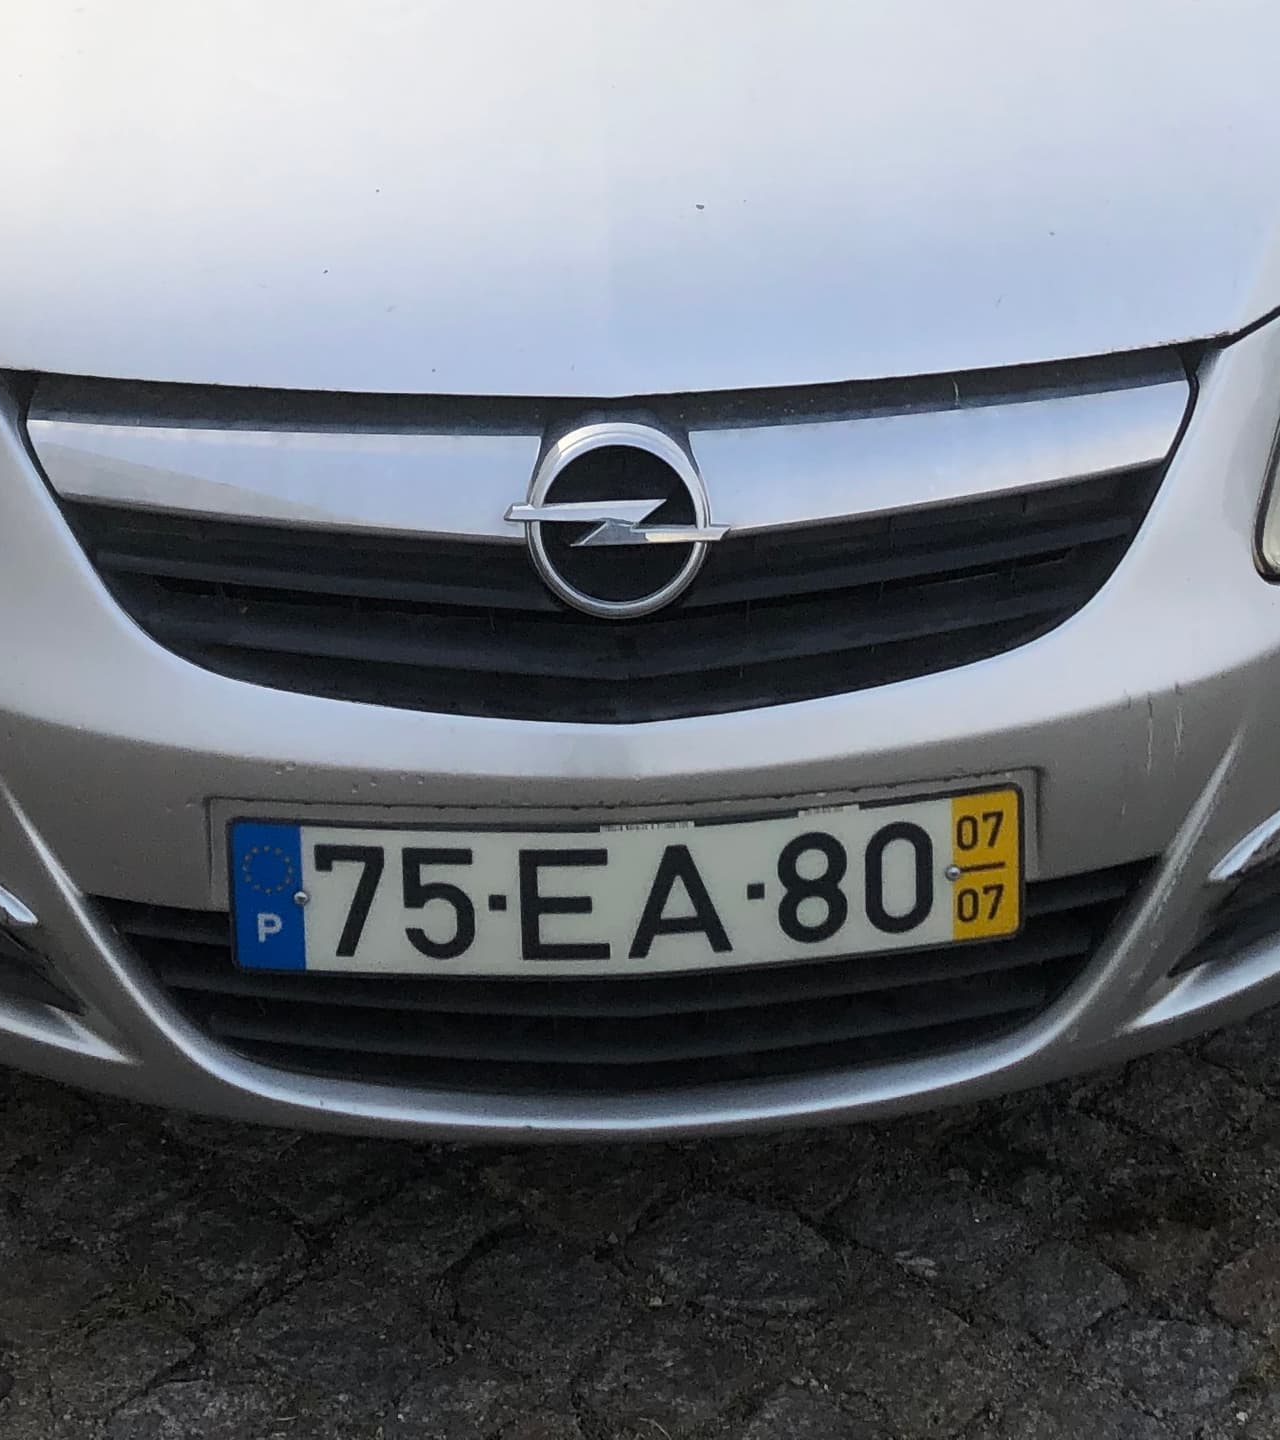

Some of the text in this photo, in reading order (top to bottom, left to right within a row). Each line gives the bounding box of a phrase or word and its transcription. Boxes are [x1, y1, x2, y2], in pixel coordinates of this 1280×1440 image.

[956, 810, 1005, 852] 07
[956, 883, 1005, 924] 07
[257, 912, 283, 944] P
